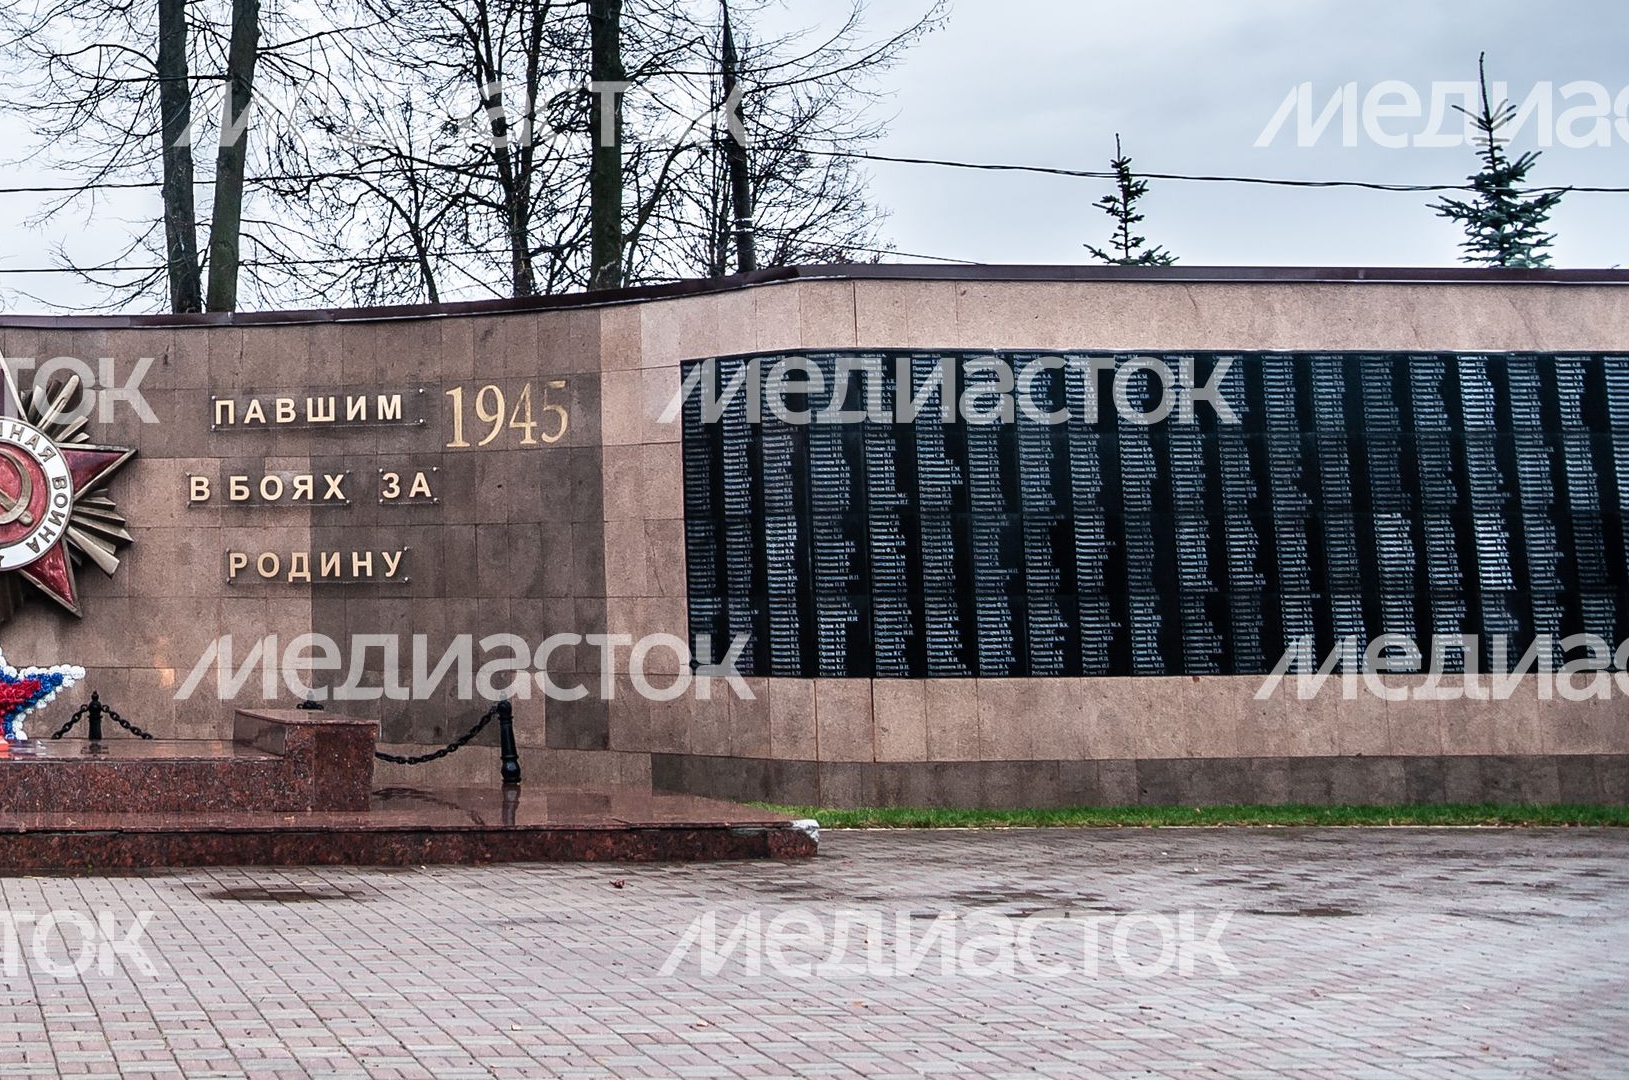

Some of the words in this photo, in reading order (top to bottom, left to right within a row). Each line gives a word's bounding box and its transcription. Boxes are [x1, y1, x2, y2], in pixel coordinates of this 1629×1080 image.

[214, 394, 403, 425] ПАВШИМ
[445, 380, 570, 448] 1945
[189, 476, 211, 502] В
[229, 473, 347, 502] БОЯХ
[381, 471, 433, 499] ЗА
[228, 550, 404, 583] РОДИНУ
